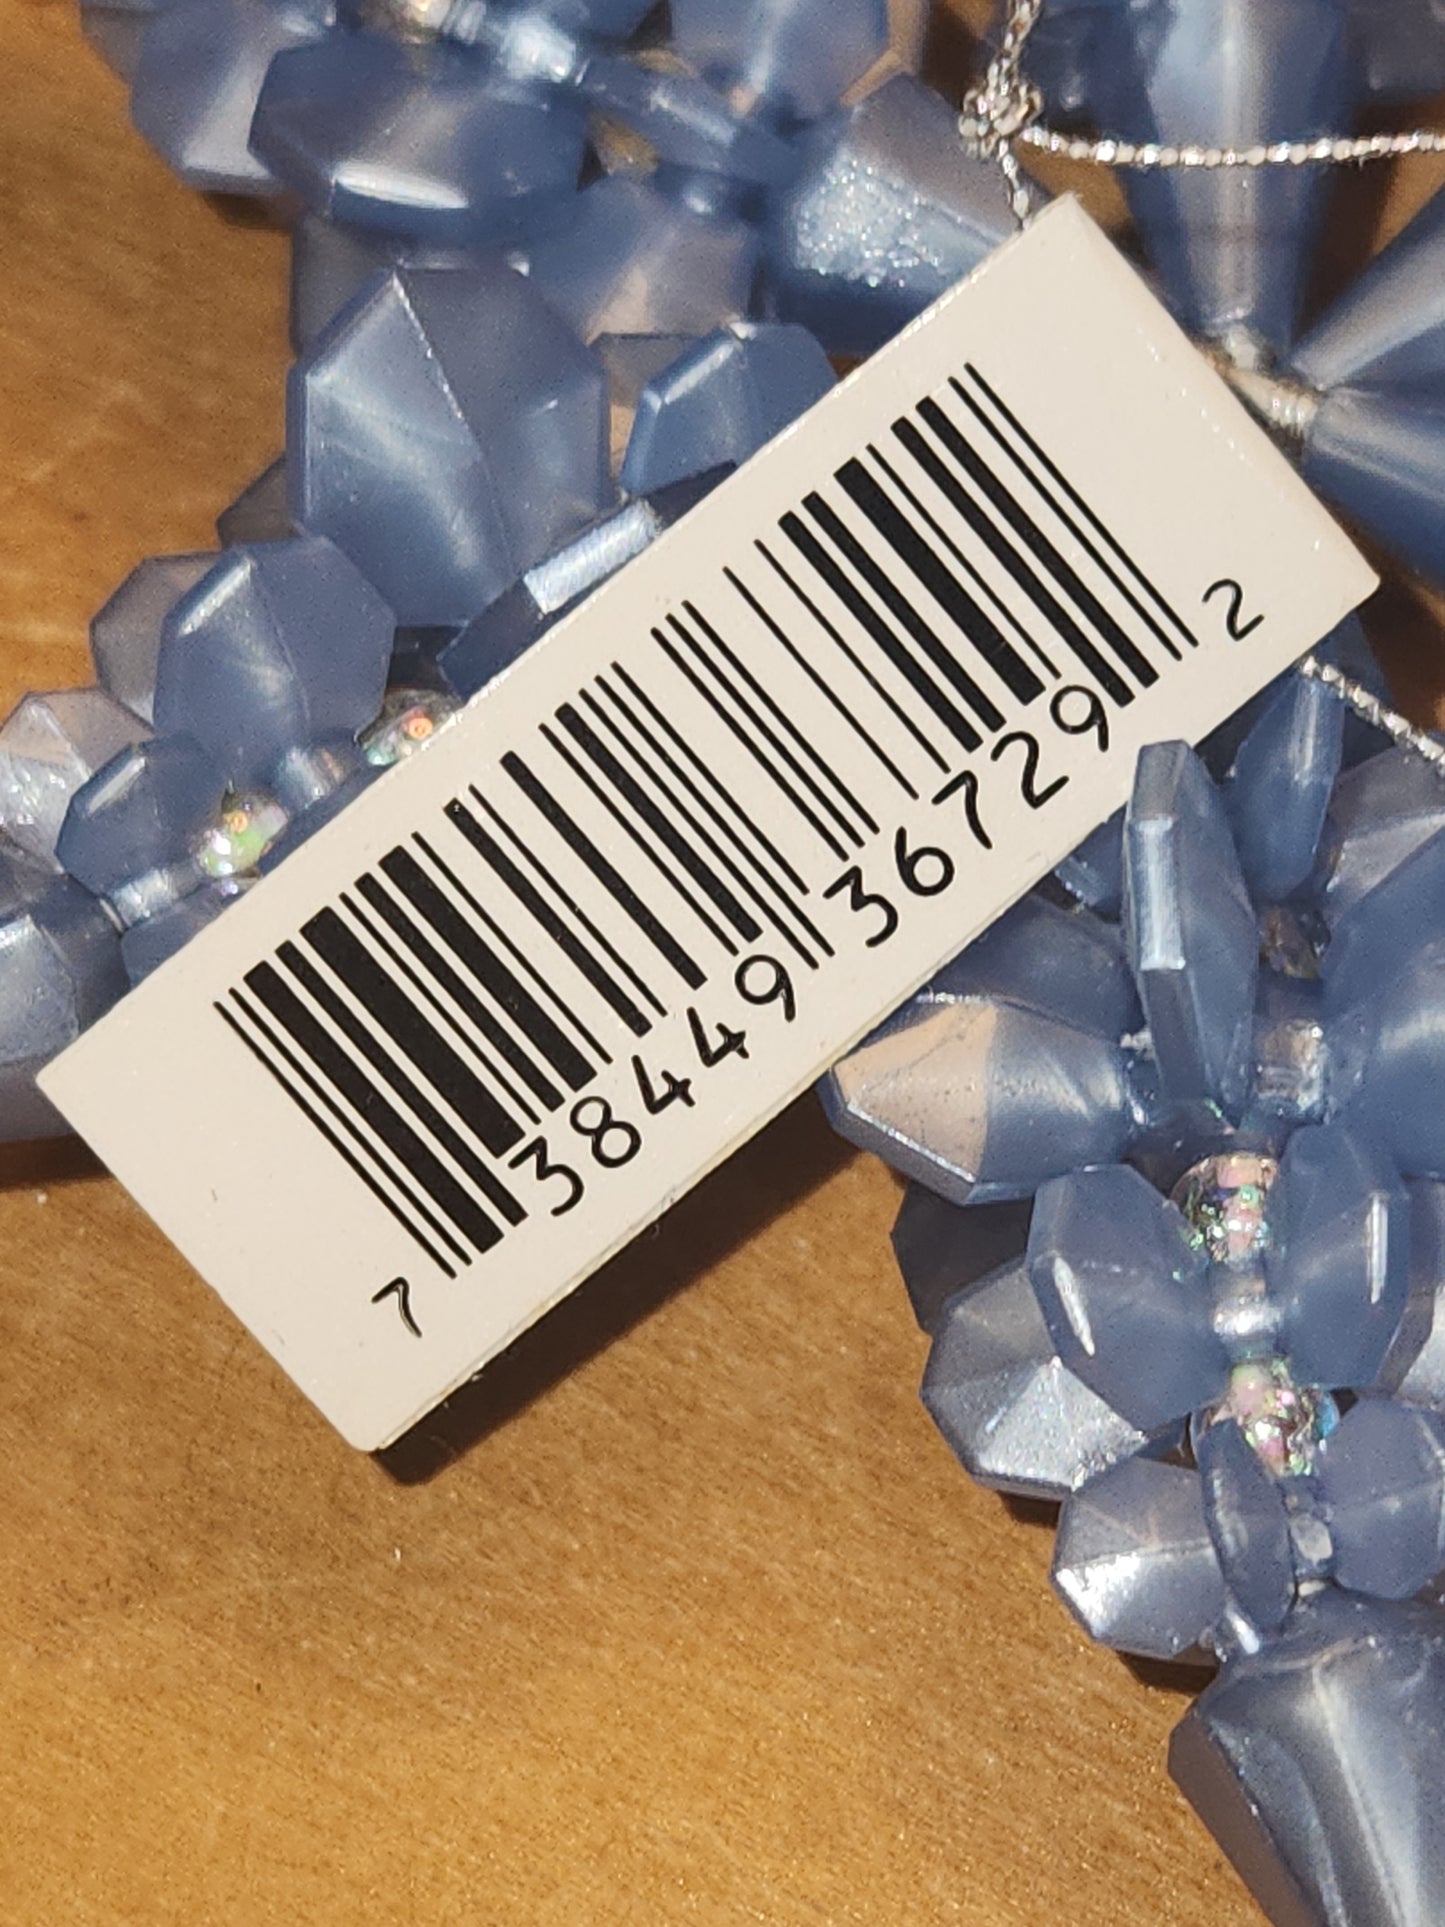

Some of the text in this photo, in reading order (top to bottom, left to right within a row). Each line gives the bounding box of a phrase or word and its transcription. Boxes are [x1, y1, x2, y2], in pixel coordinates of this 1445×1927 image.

[371, 578, 1265, 1338] 7 38449 36729 2
